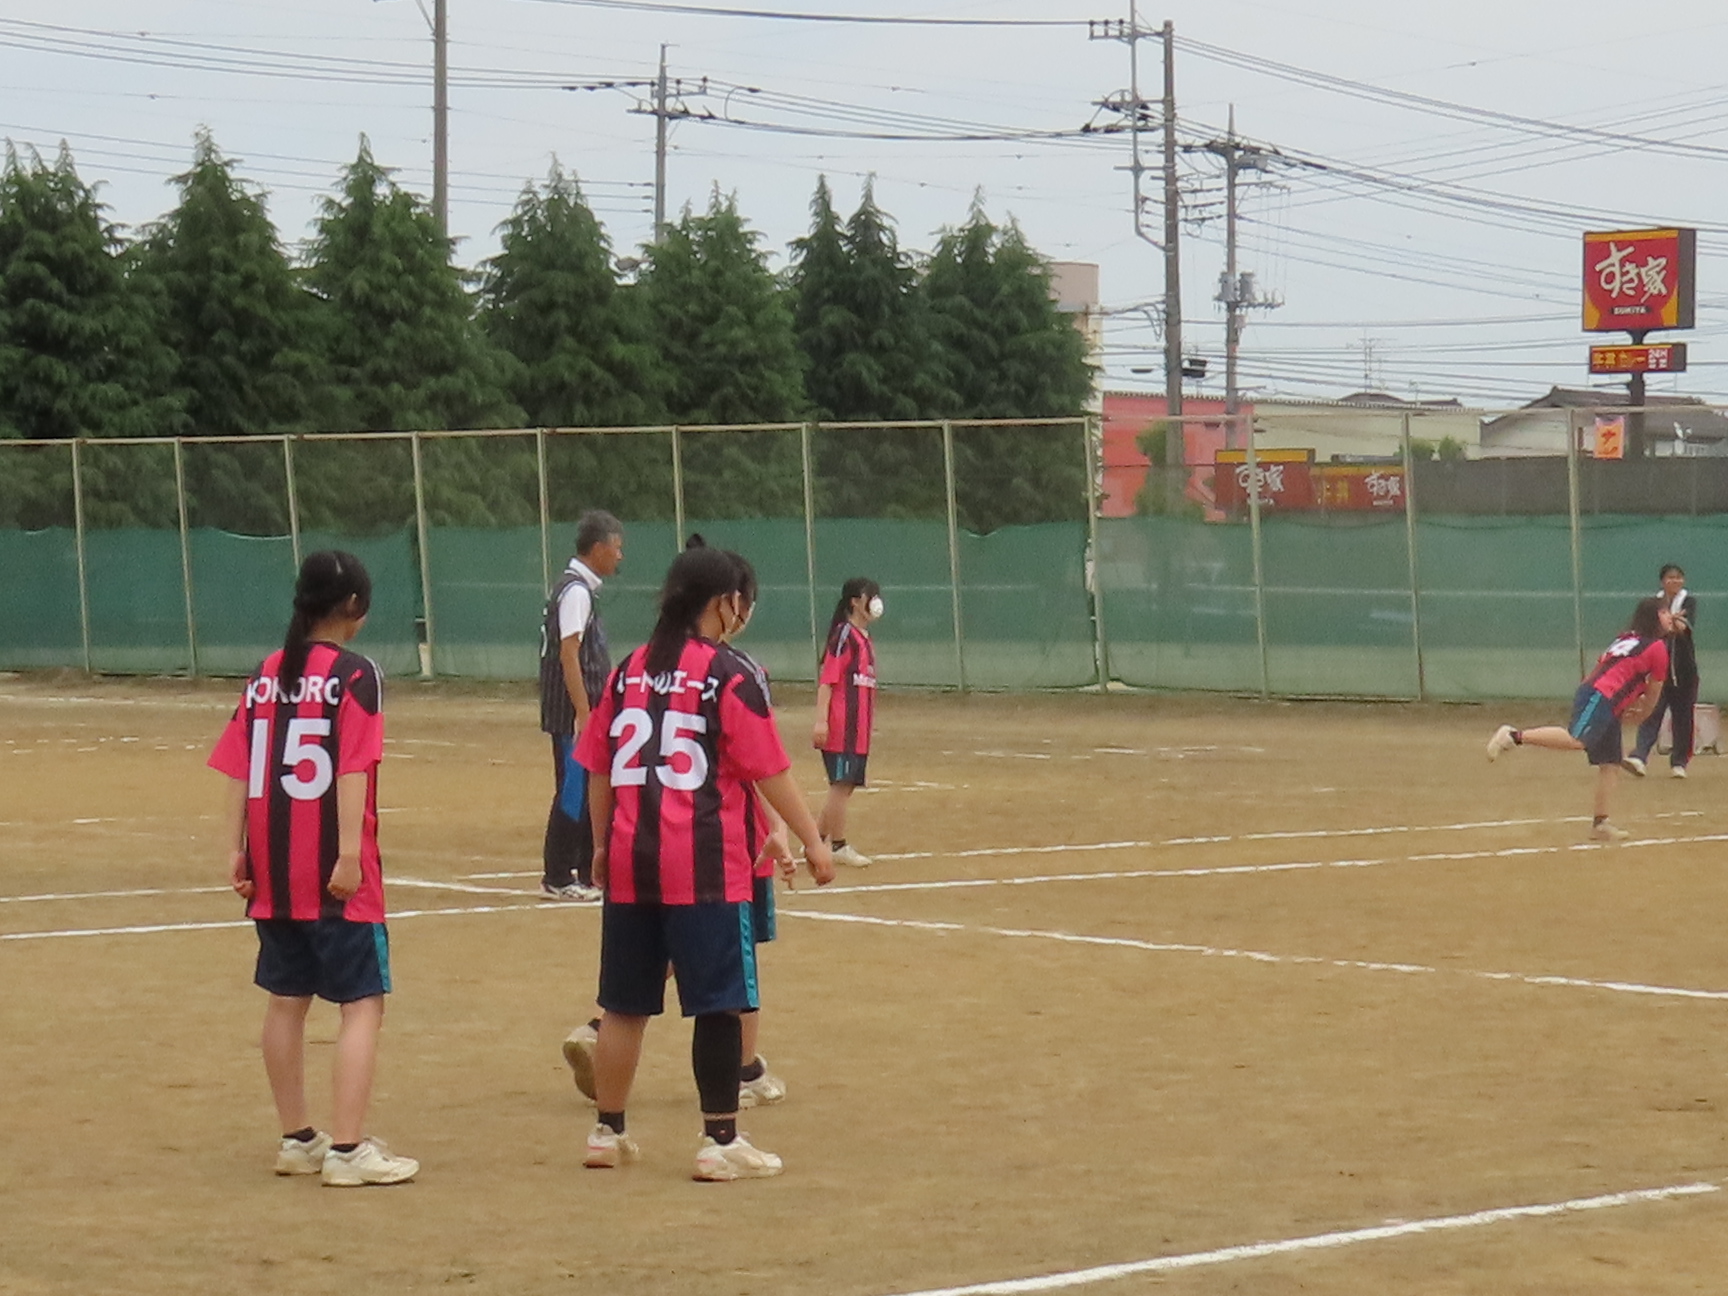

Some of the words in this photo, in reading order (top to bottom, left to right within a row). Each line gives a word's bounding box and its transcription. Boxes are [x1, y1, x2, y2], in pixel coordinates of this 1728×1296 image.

[1595, 242, 1668, 303] すき家
[248, 718, 334, 801] 15
[609, 707, 709, 791] 25
